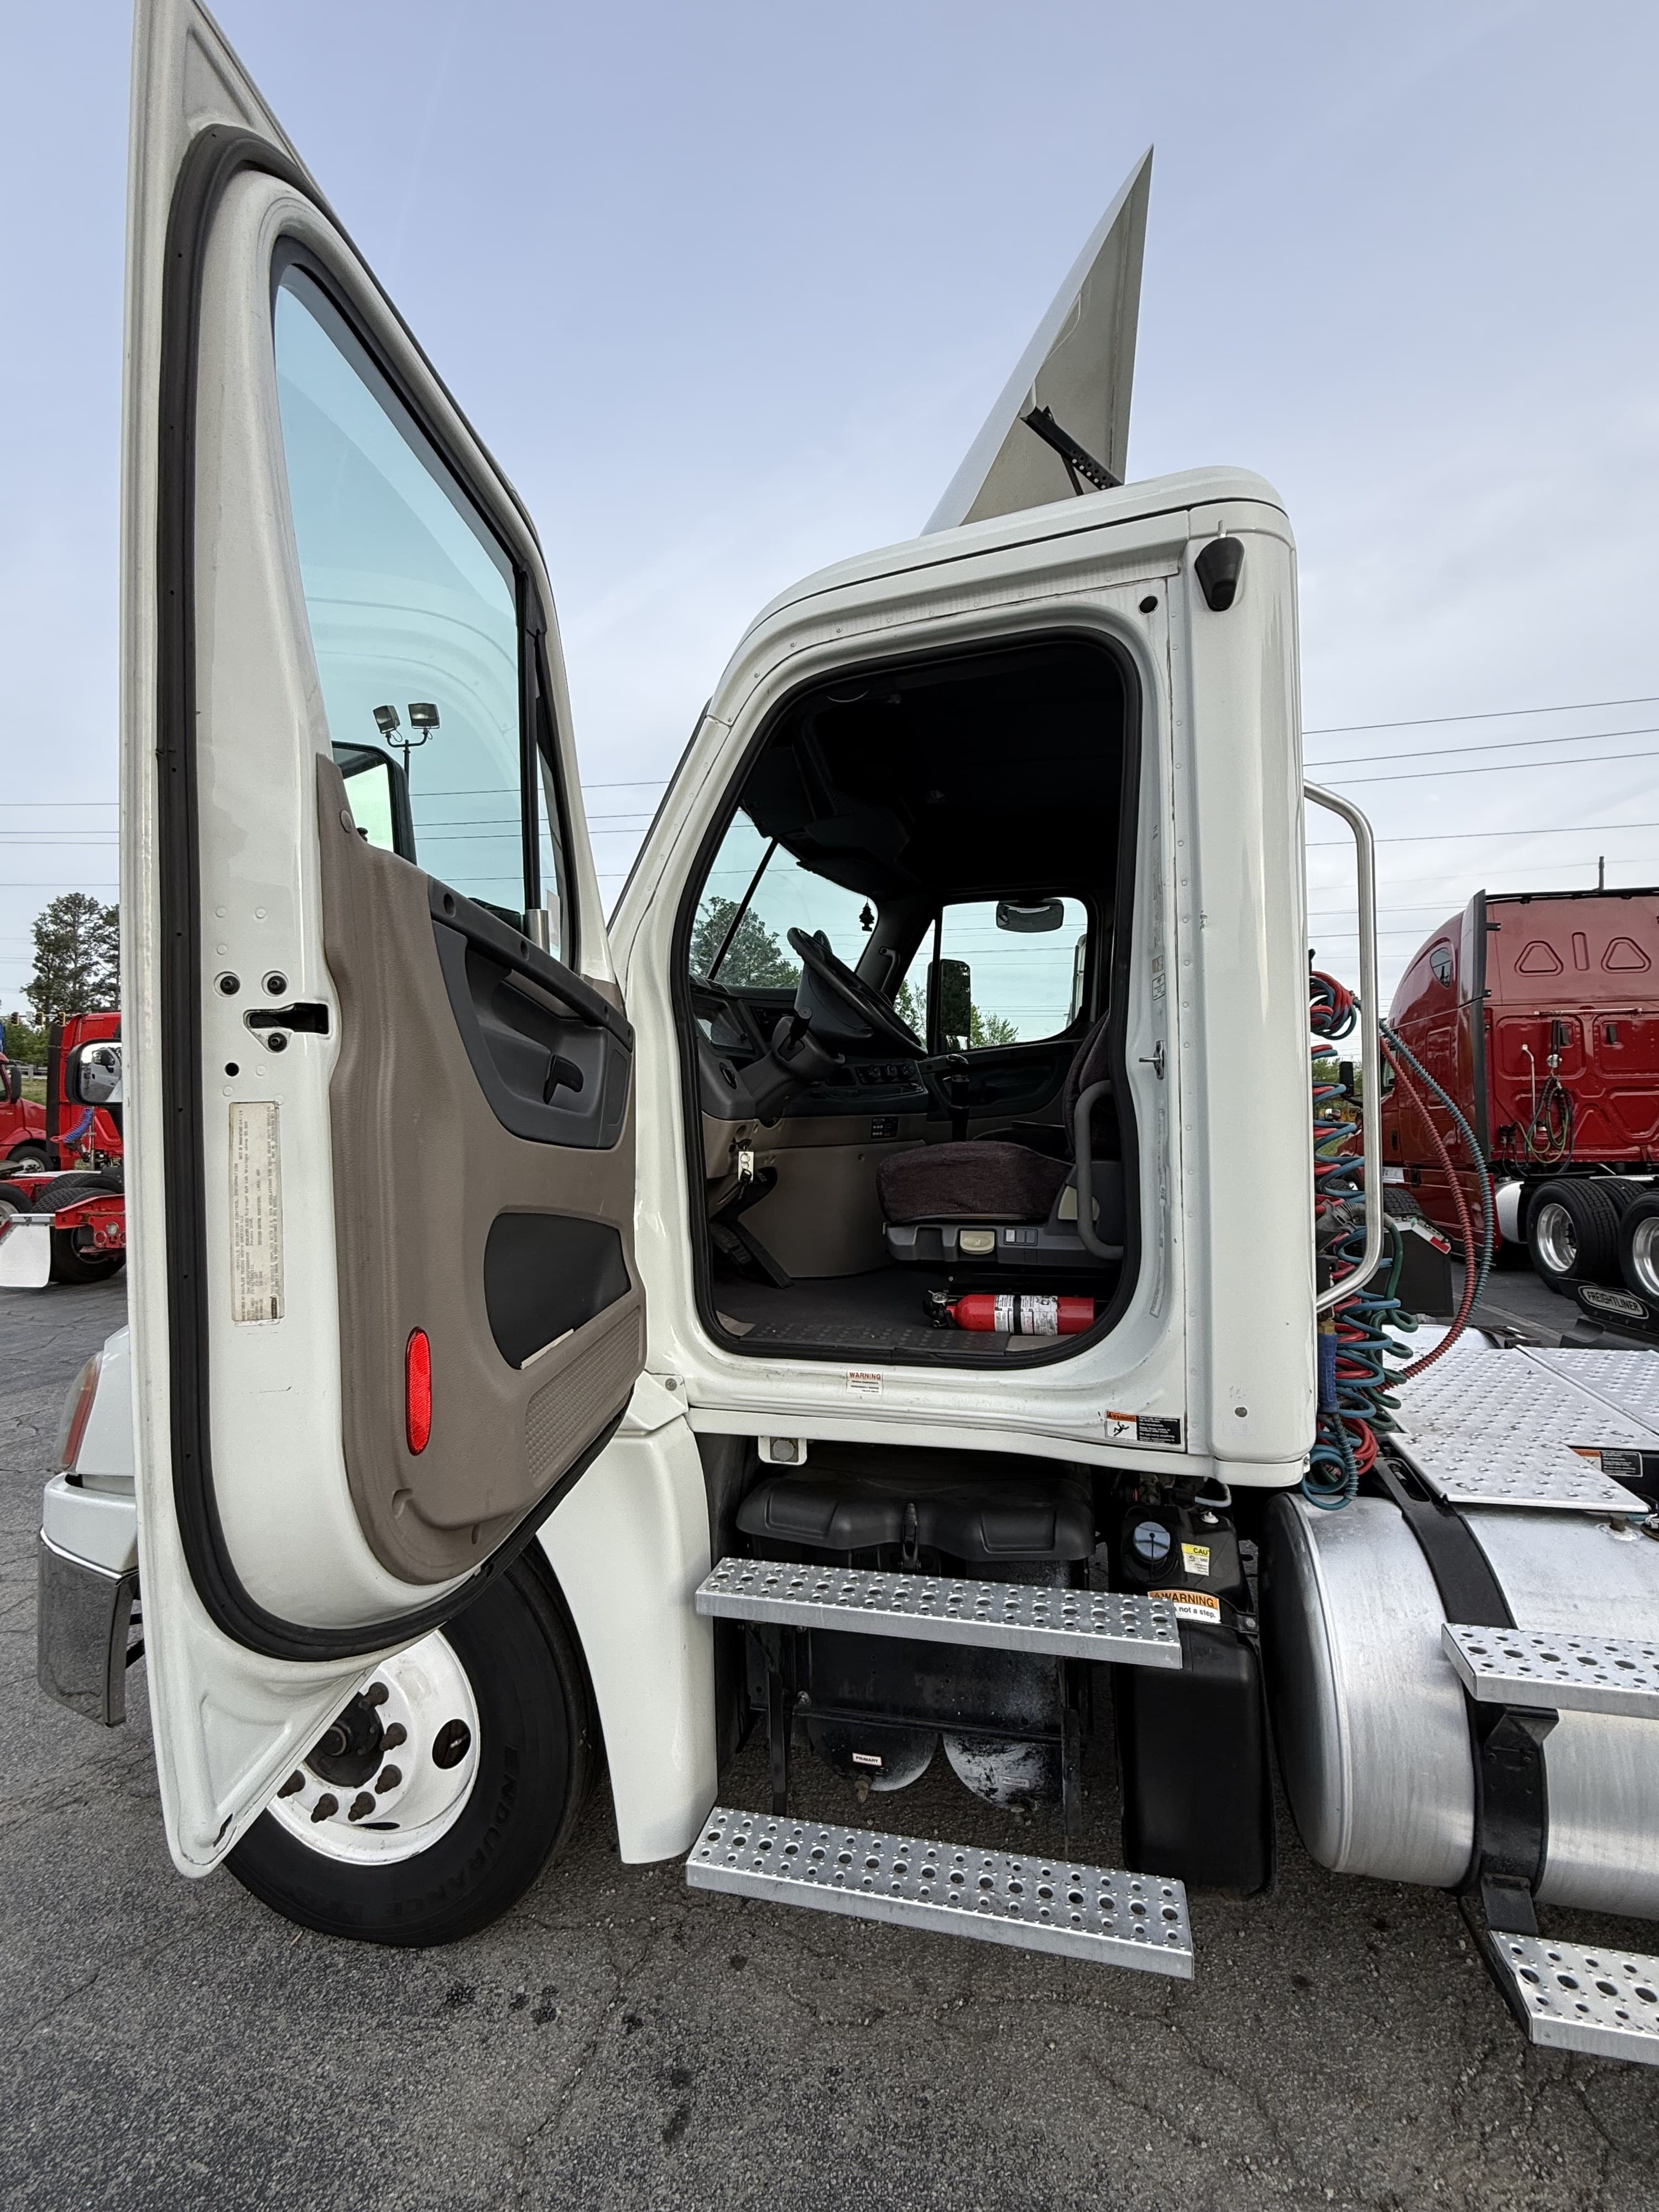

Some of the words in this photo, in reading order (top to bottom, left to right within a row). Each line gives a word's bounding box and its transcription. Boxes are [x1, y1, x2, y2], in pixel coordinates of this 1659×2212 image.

[1587, 1291, 1640, 1312] FREIGHTLINER
[1161, 1593, 1214, 1608] WARNING
[1199, 1610, 1216, 1618] step.
